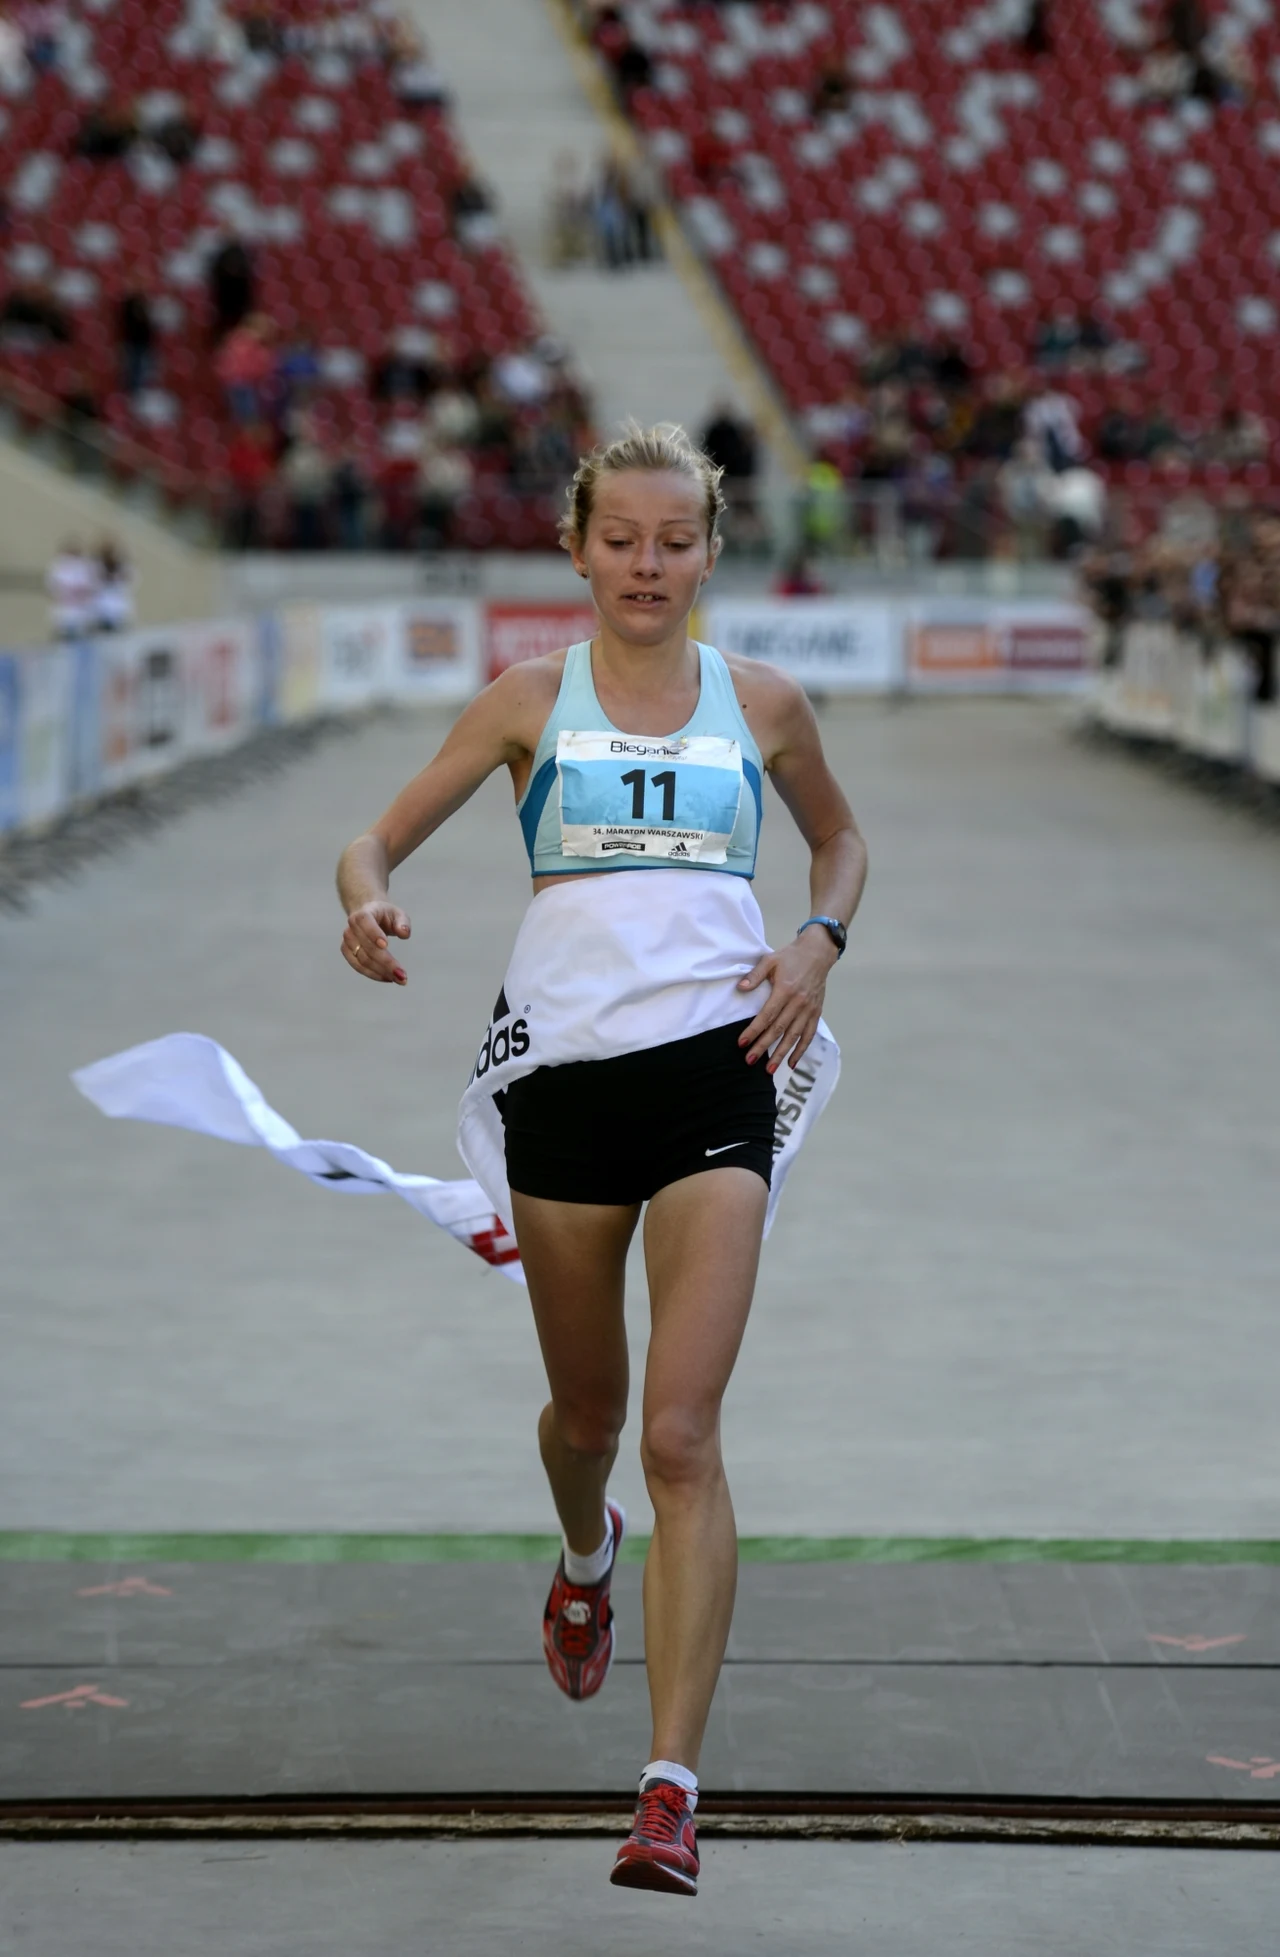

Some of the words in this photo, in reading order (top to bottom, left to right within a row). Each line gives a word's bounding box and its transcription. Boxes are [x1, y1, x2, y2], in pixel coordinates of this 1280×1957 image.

[620, 768, 676, 821] 11
[593, 828, 604, 836] 34.
[647, 828, 703, 840] WARSZAWSKI
[471, 1018, 530, 1080] das
[772, 1067, 816, 1154] WSKI
